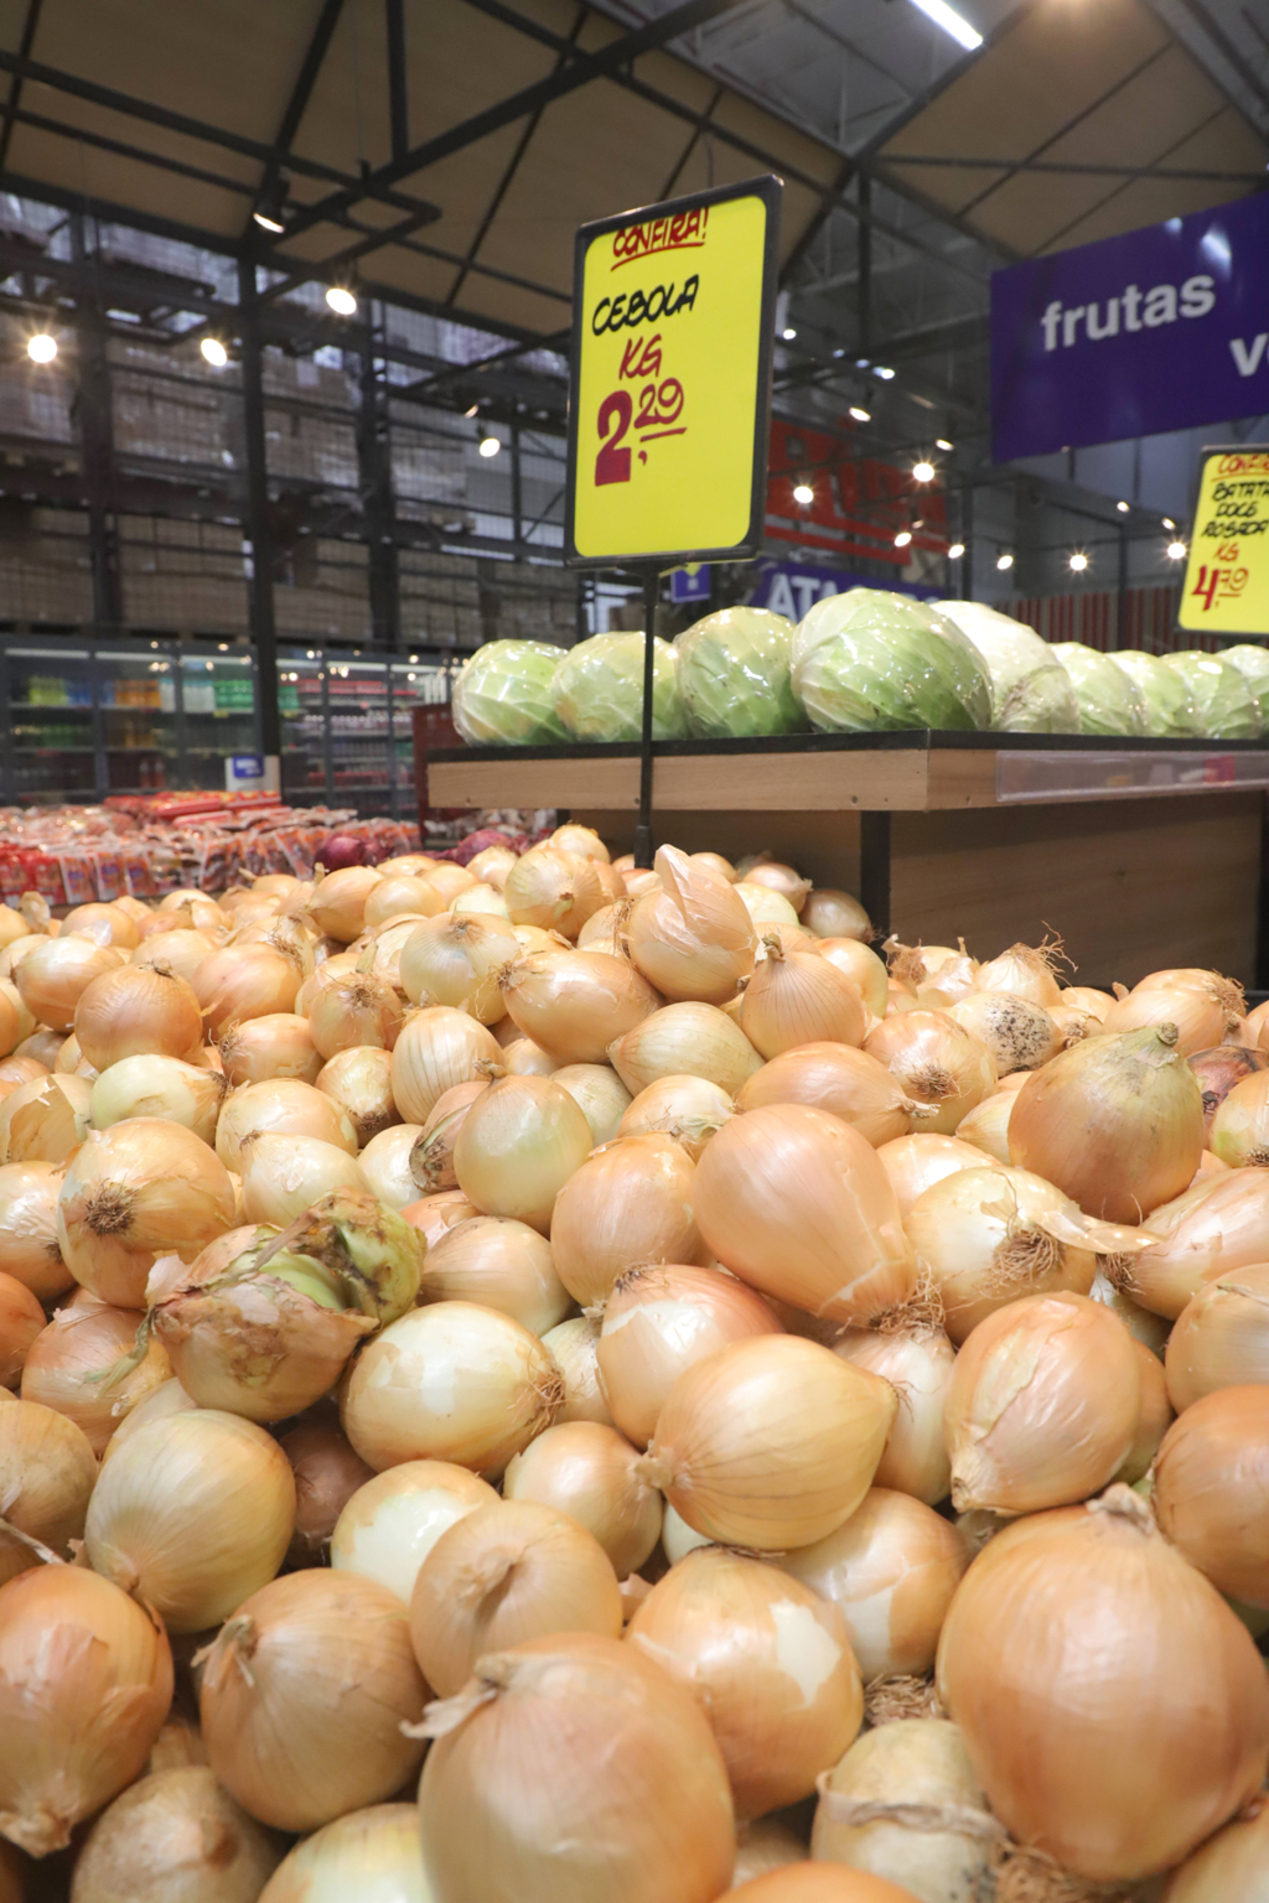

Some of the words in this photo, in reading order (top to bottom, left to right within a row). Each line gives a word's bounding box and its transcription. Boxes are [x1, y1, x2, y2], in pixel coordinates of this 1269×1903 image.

[592, 273, 699, 336] CEBOLA
[1041, 275, 1216, 352] frutas
[619, 333, 662, 381] KG
[1229, 333, 1269, 378] v
